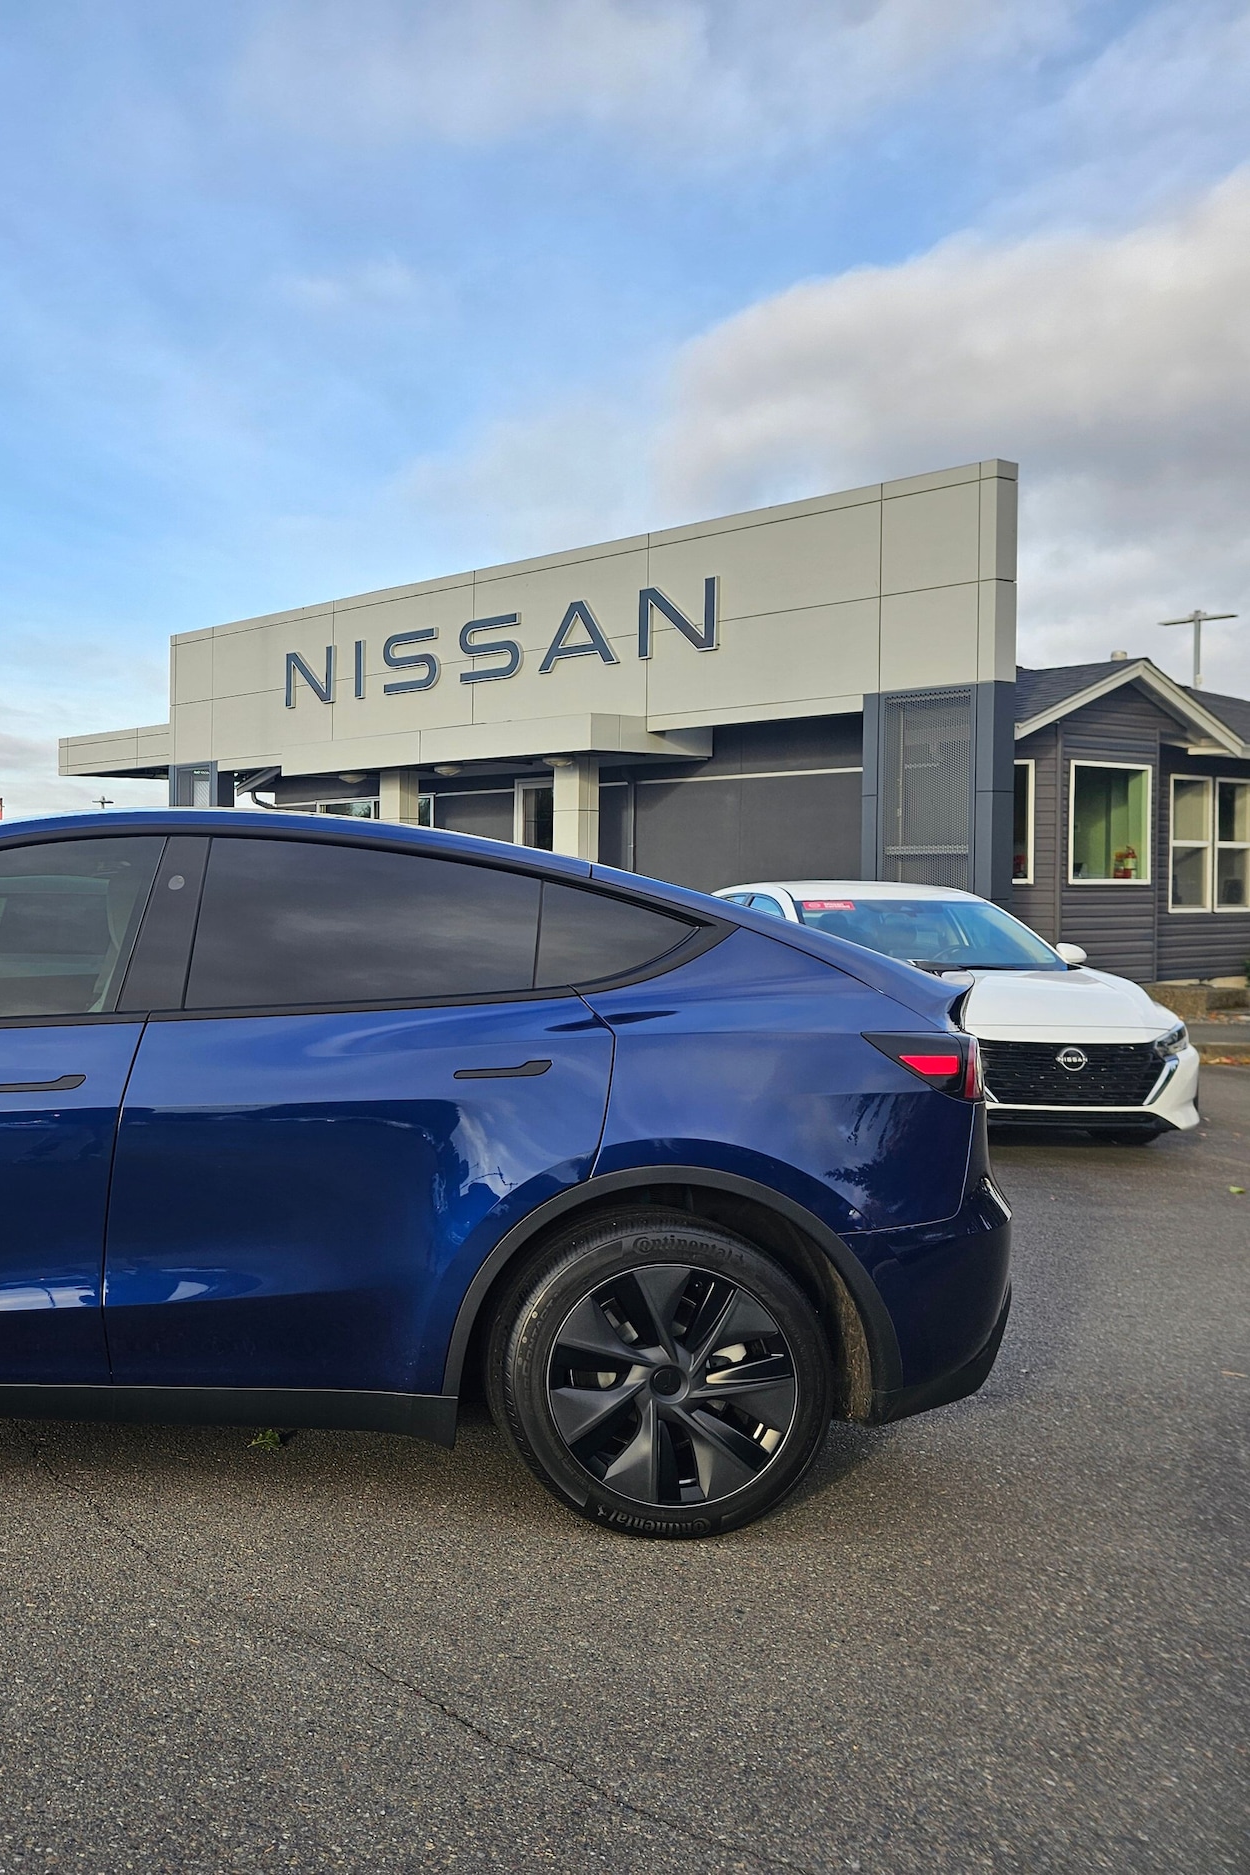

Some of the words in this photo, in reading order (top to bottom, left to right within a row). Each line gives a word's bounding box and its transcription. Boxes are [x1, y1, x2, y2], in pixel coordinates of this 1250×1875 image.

[286, 576, 720, 708] NISSAN
[632, 1234, 733, 1261] Continental
[608, 1509, 711, 1535] Continental
